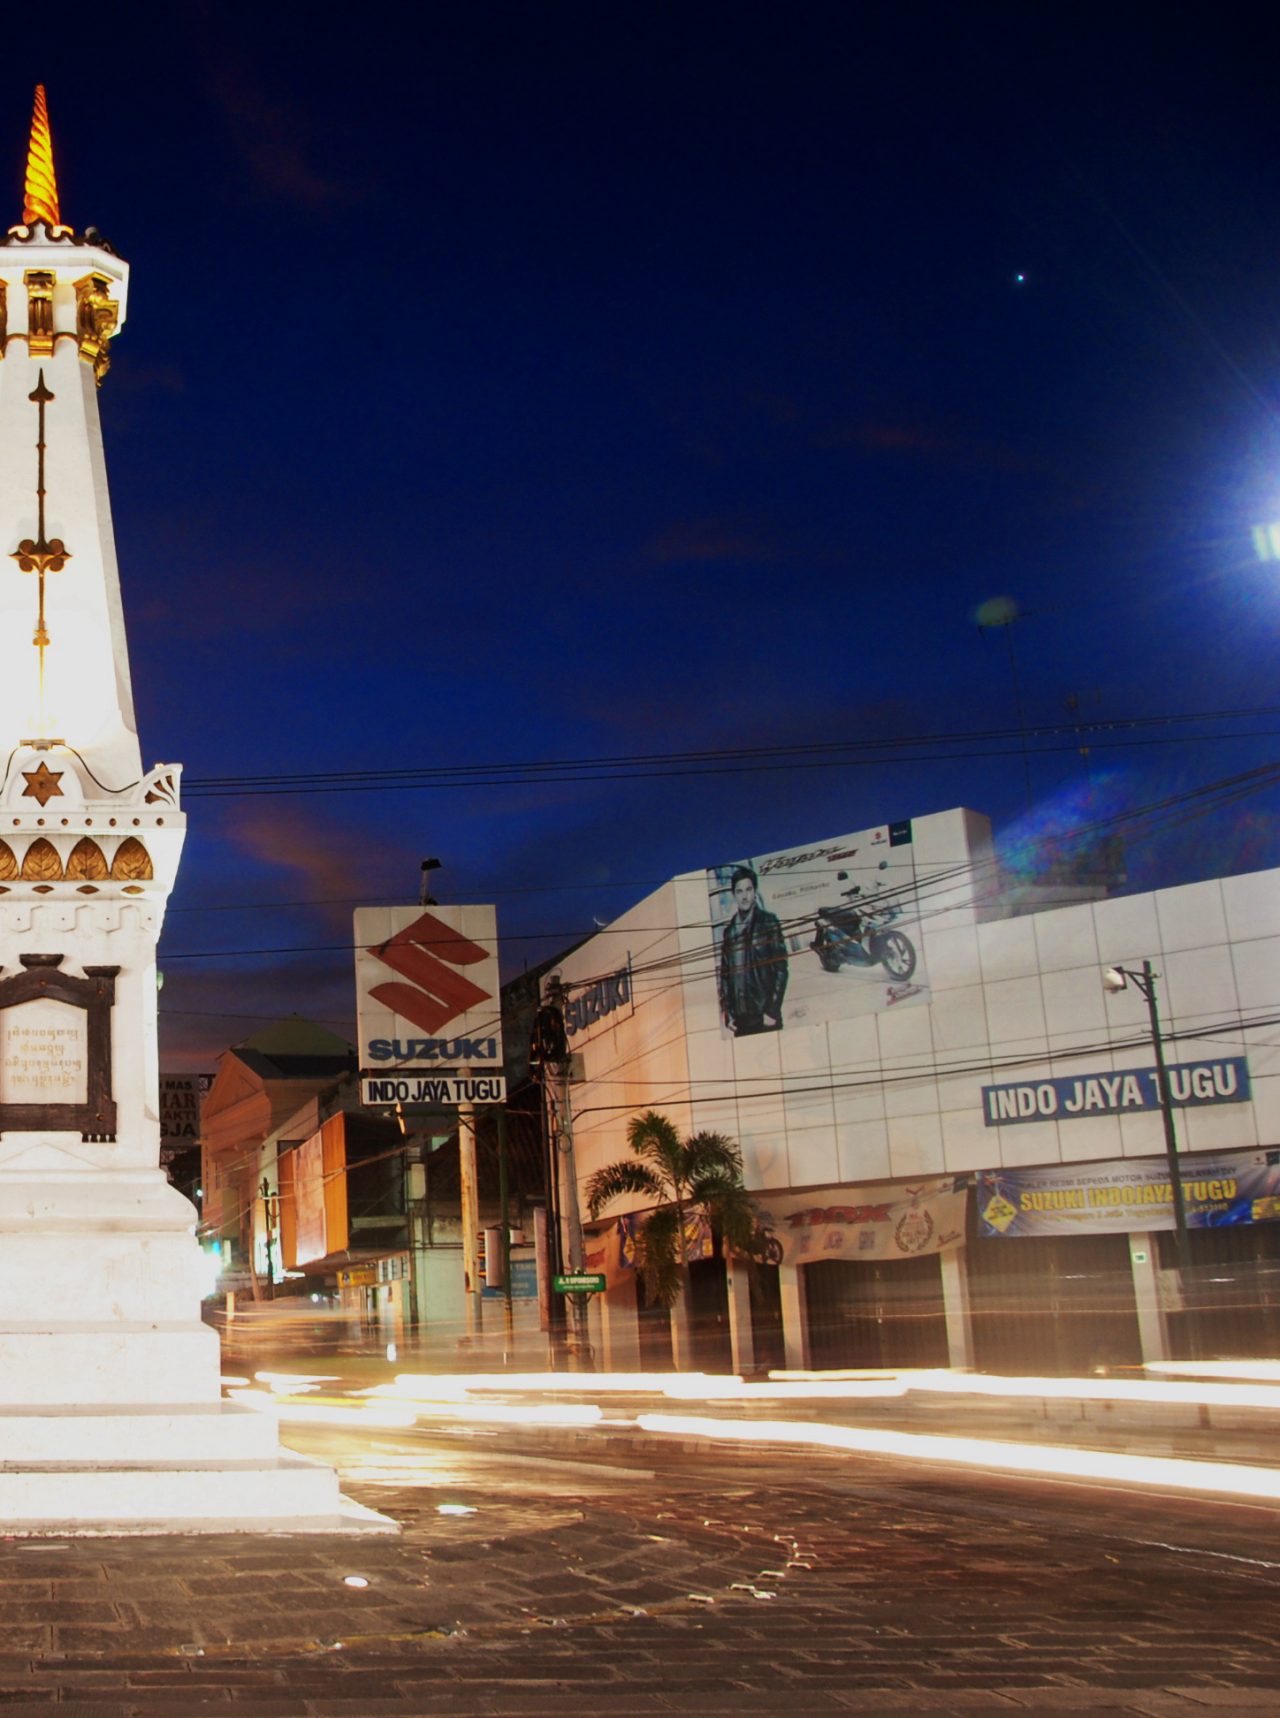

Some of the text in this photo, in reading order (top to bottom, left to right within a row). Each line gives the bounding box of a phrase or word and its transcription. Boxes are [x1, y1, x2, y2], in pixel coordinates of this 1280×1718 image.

[565, 974, 630, 1036] SUZUKI
[368, 1038, 497, 1061] SUZUKI
[368, 1079, 501, 1102] INDO JAYA TUGU
[988, 1084, 1058, 1120] INDO
[1064, 1075, 1144, 1113] JAYA
[160, 1111, 196, 1121] AKTI
[1111, 1172, 1142, 1183] MOTOR
[1144, 1170, 1174, 1182] SUZU
[1020, 1187, 1086, 1211] SUZUKI
[1088, 1182, 1174, 1208] INDOJAYA
[1182, 1178, 1238, 1201] TUGU
